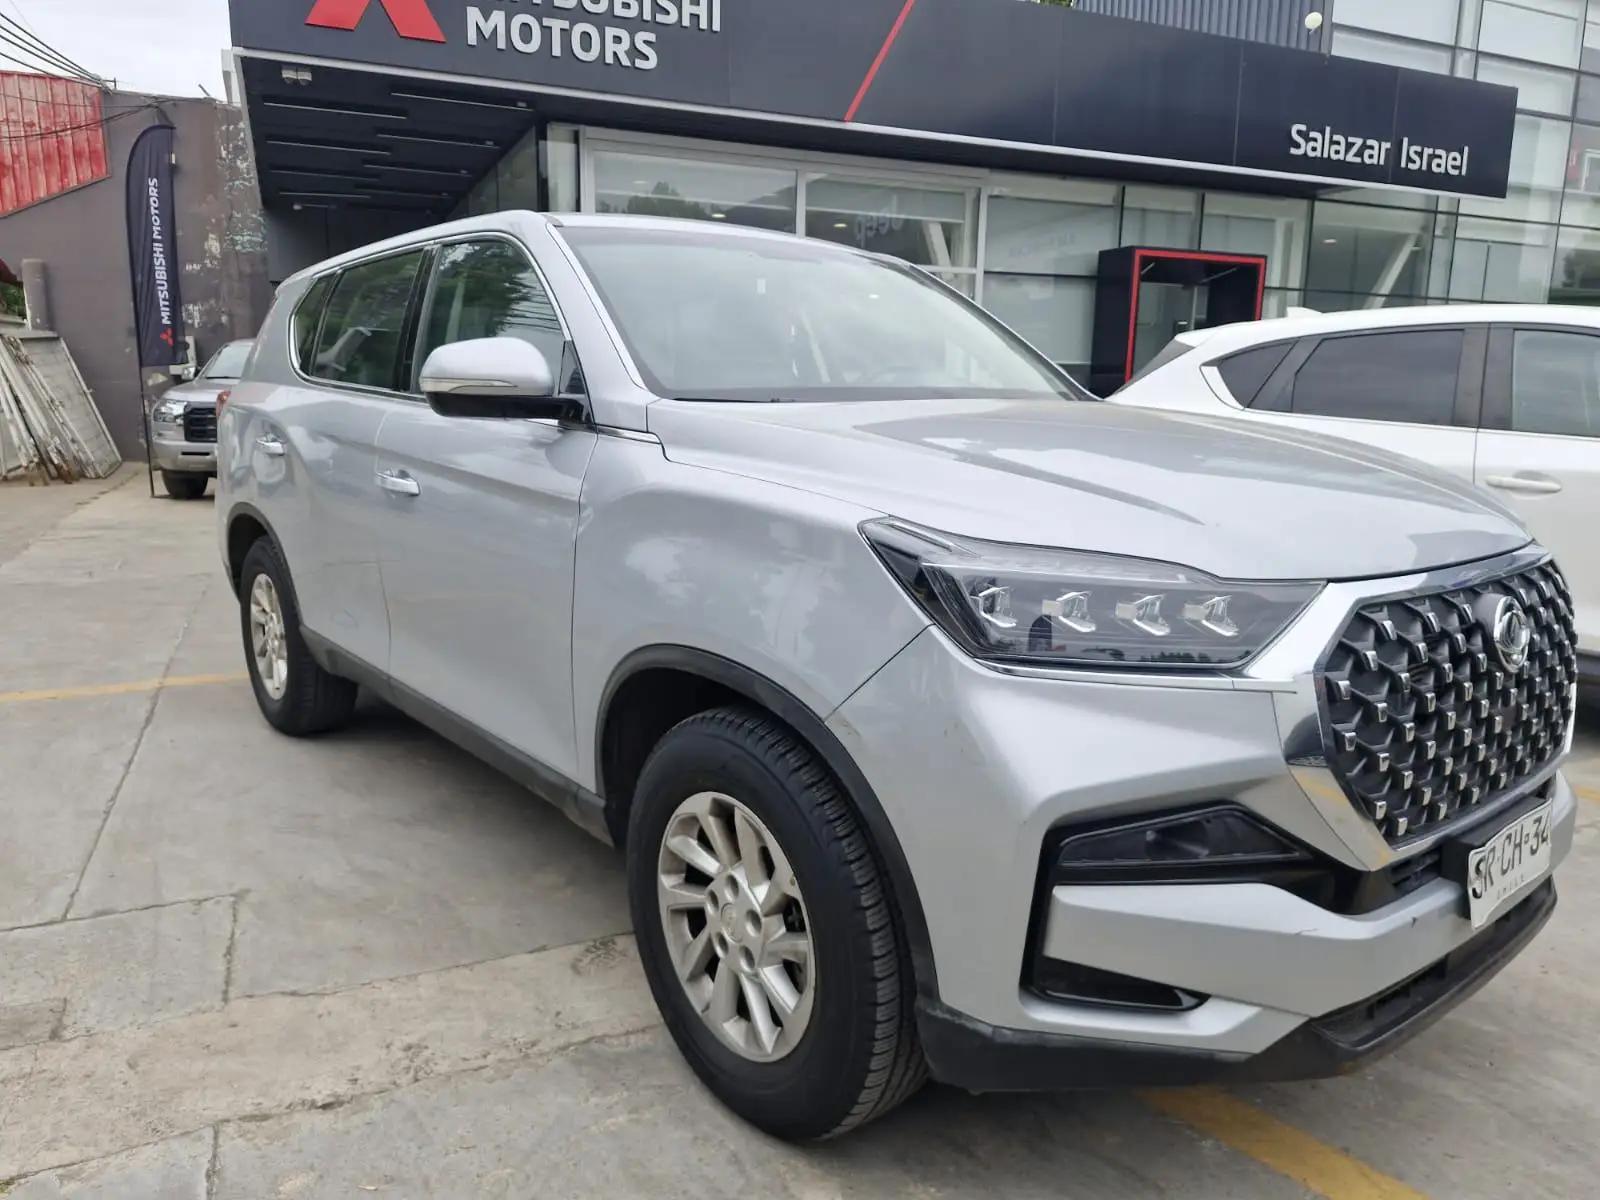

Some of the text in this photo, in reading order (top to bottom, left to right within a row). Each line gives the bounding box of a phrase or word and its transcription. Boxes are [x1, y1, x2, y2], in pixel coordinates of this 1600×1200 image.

[466, 6, 658, 70] MOTORS
[1289, 123, 1469, 176] Salazar Israel
[148, 177, 172, 325] MITSUBISHI MOTORS
